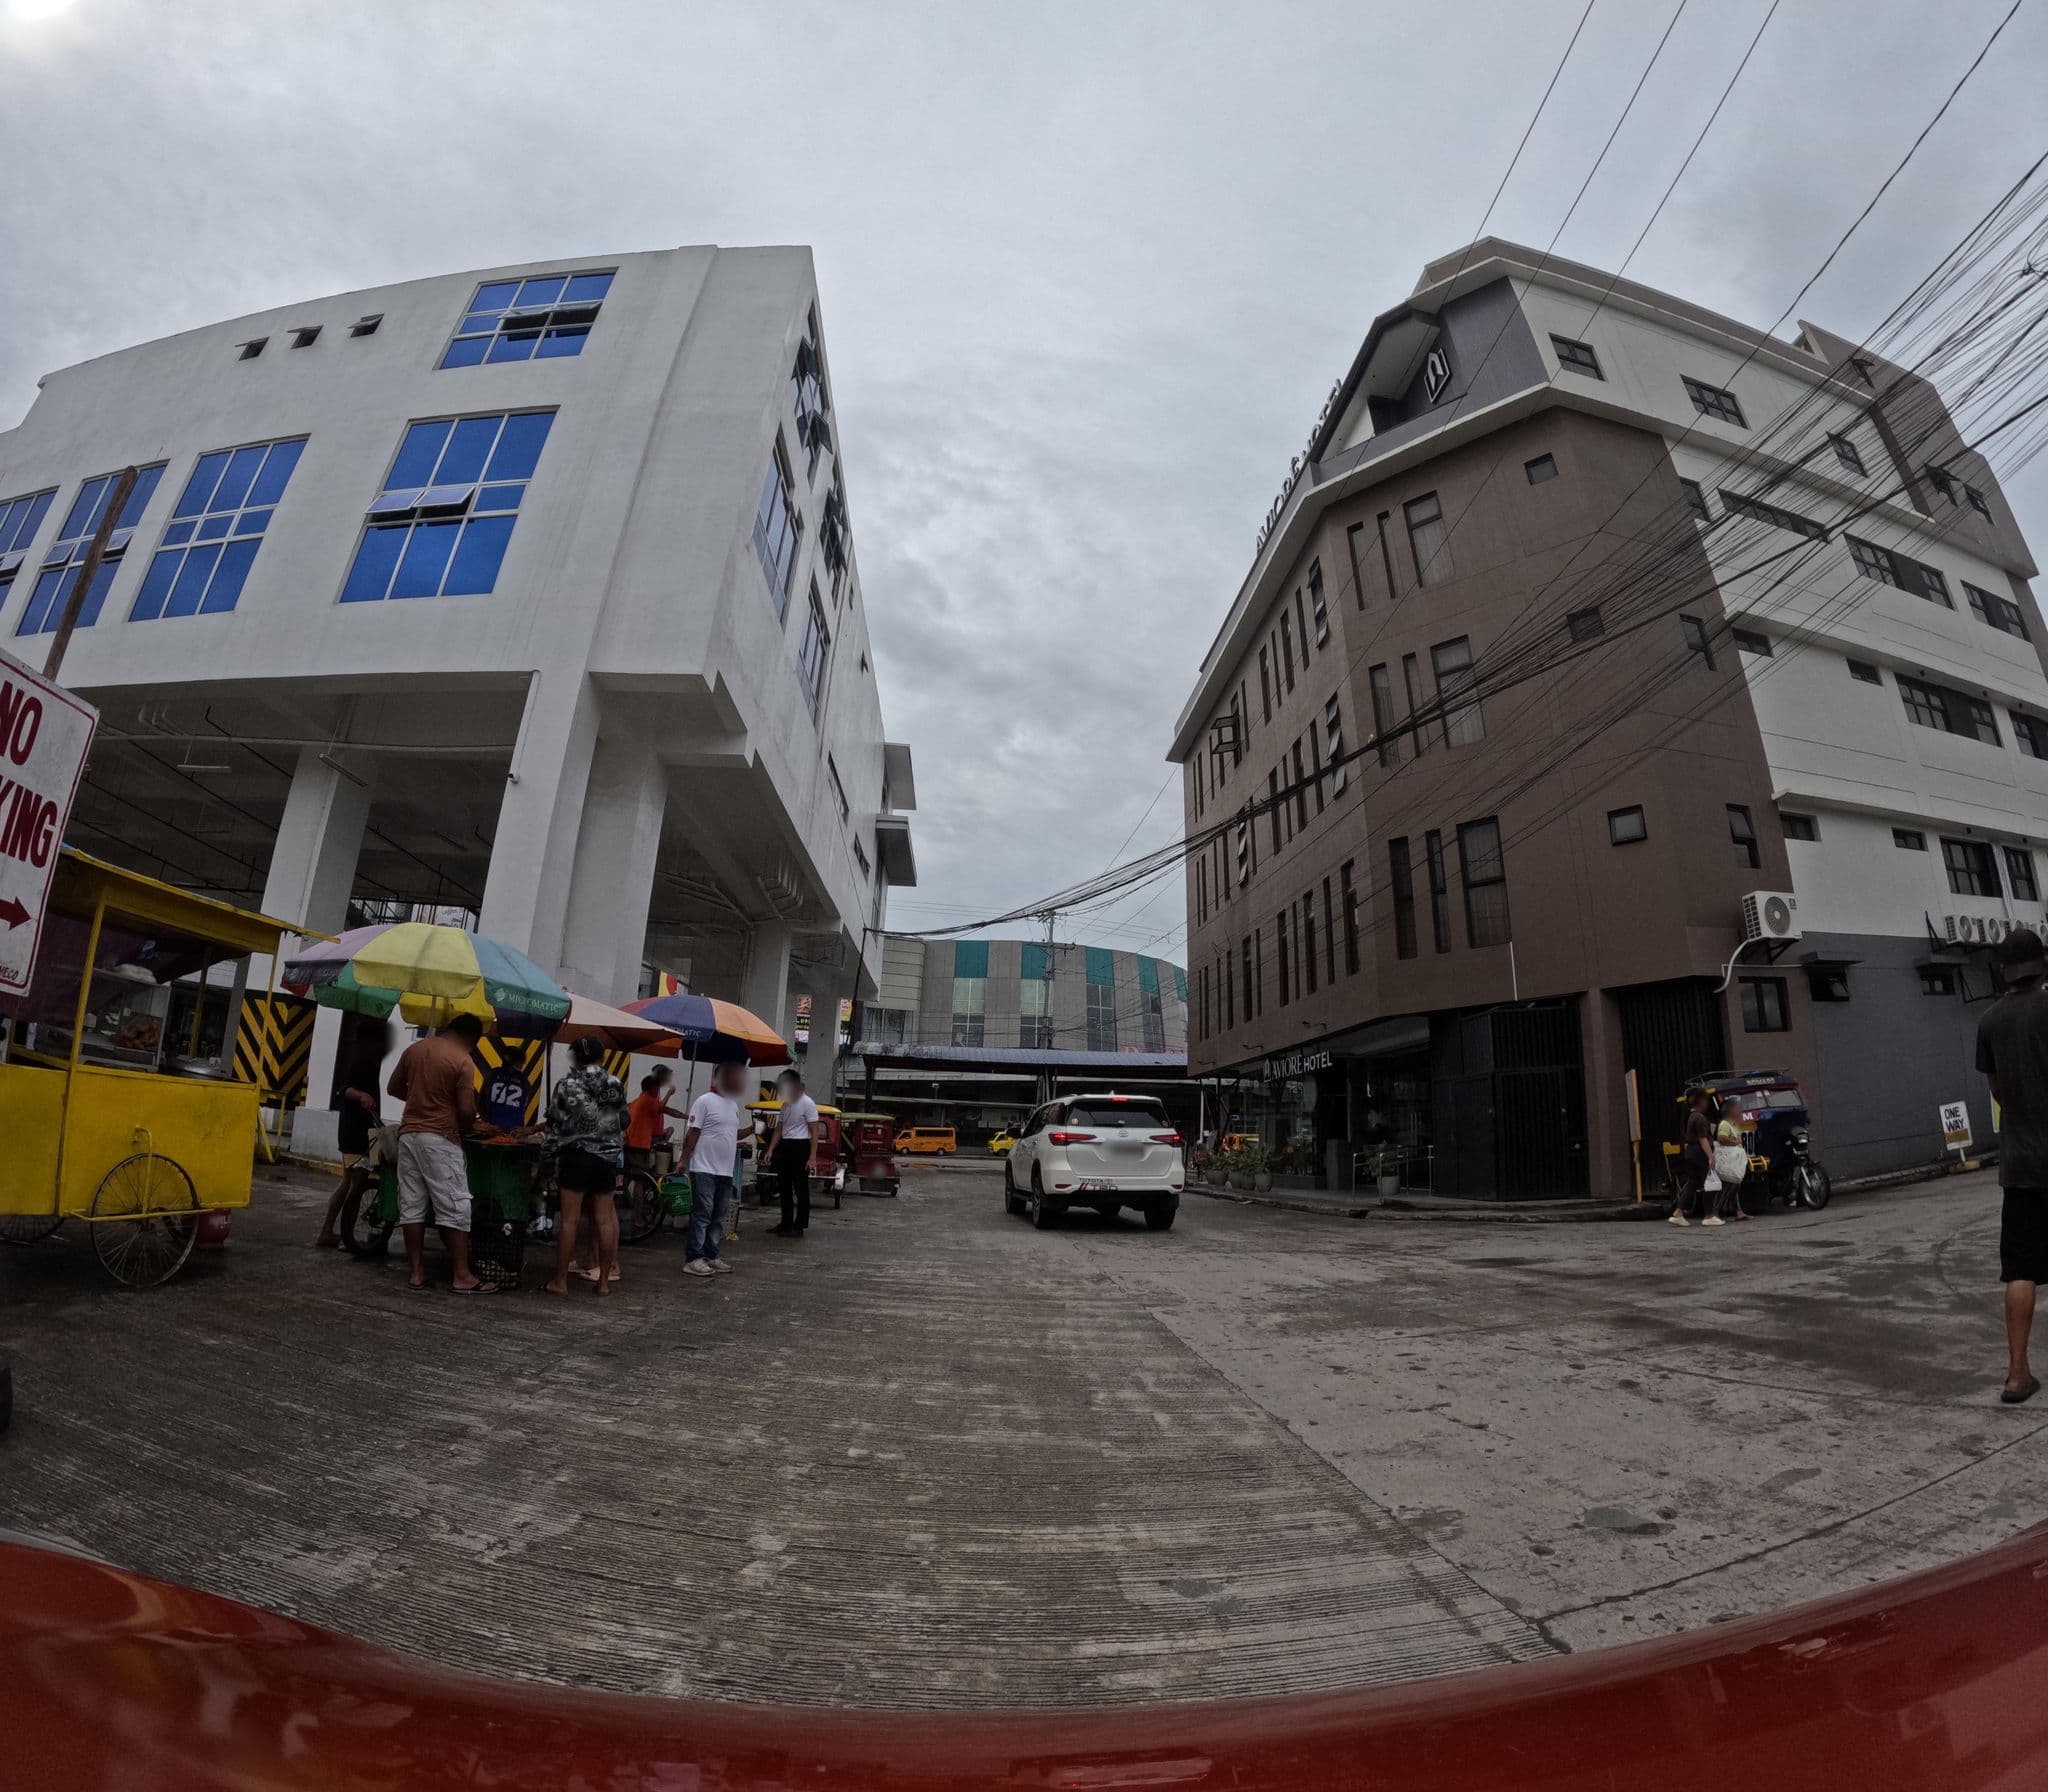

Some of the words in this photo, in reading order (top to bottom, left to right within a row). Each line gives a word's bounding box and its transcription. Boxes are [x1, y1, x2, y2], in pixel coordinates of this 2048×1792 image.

[0, 680, 43, 766] NO
[1272, 1055, 1303, 1081] AVIORE
[1303, 1051, 1333, 1072] HOTEL
[1944, 1106, 1961, 1120] ONE
[1945, 1118, 1964, 1132] WAY
